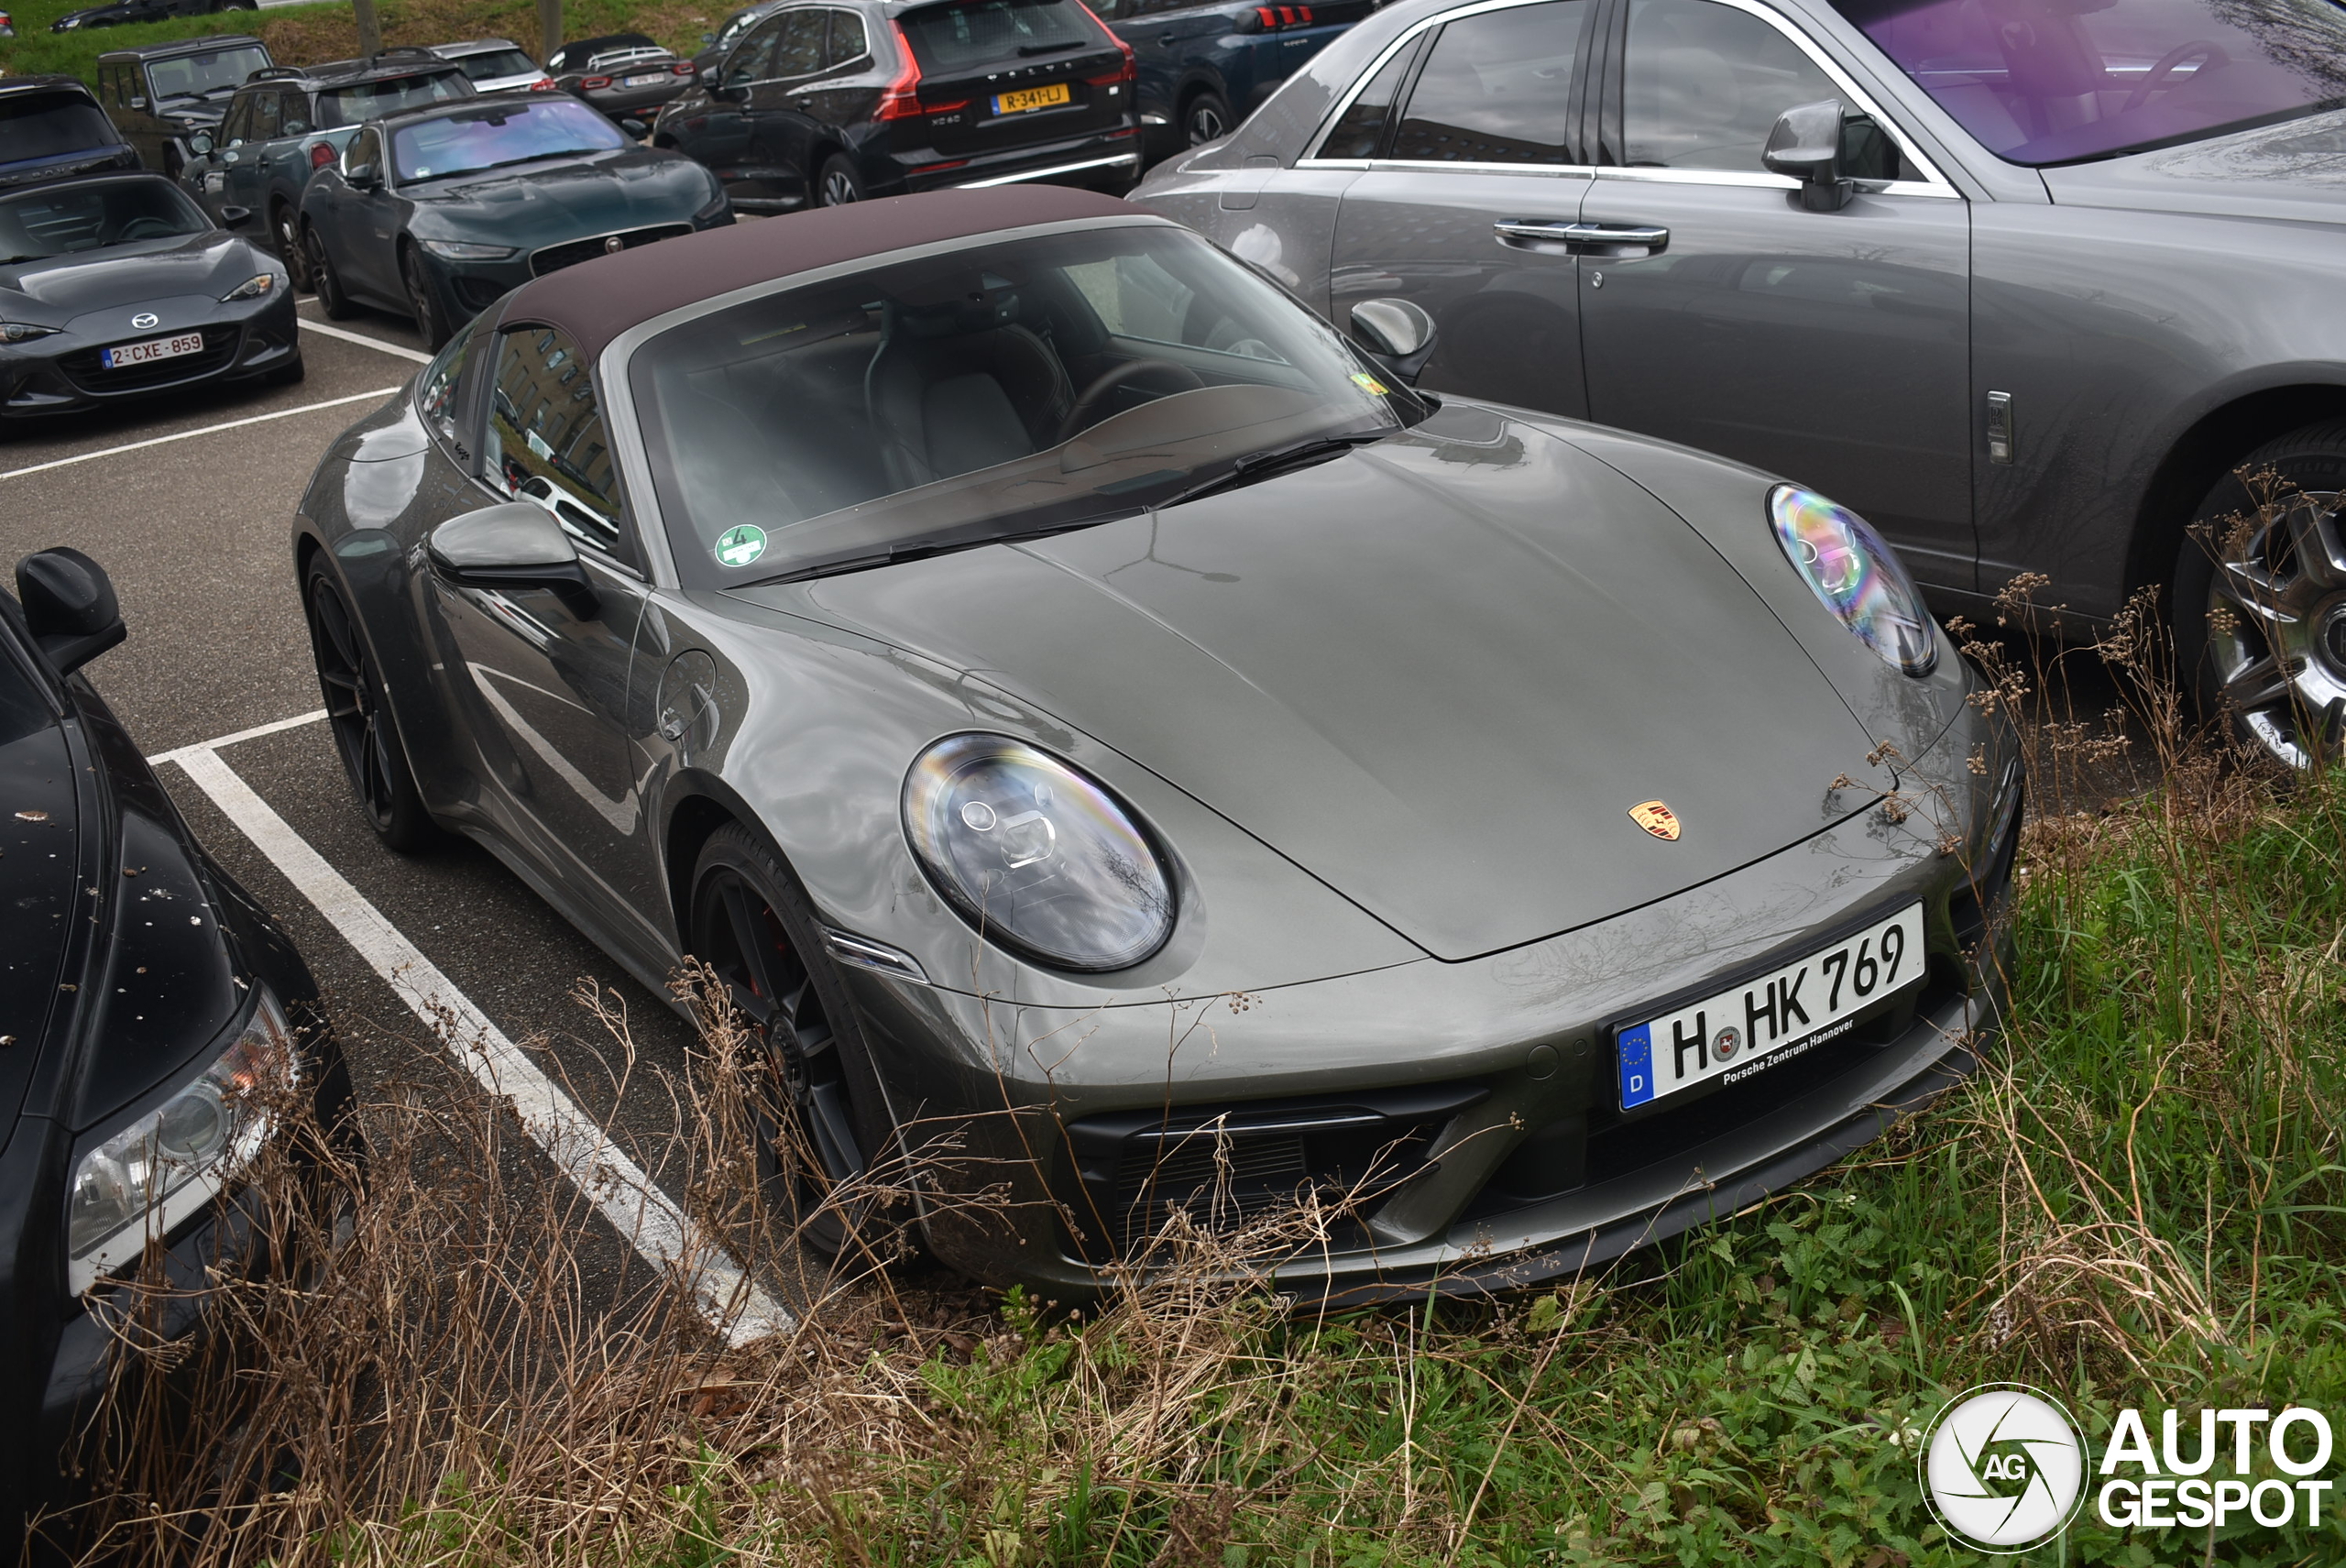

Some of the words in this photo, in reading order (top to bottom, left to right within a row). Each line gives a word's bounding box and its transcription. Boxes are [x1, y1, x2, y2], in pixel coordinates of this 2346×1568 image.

[1006, 87, 1061, 110] R-341-LJ
[733, 528, 747, 544] 4
[1672, 1010, 1707, 1080] H
[1744, 966, 1811, 1049] HK
[1822, 924, 1904, 1013] 769
[1724, 1061, 1765, 1085] Porsche
[1767, 1042, 1808, 1067] Zentrum
[1810, 1019, 1854, 1047] Hannover
[1630, 1075, 1643, 1093] D
